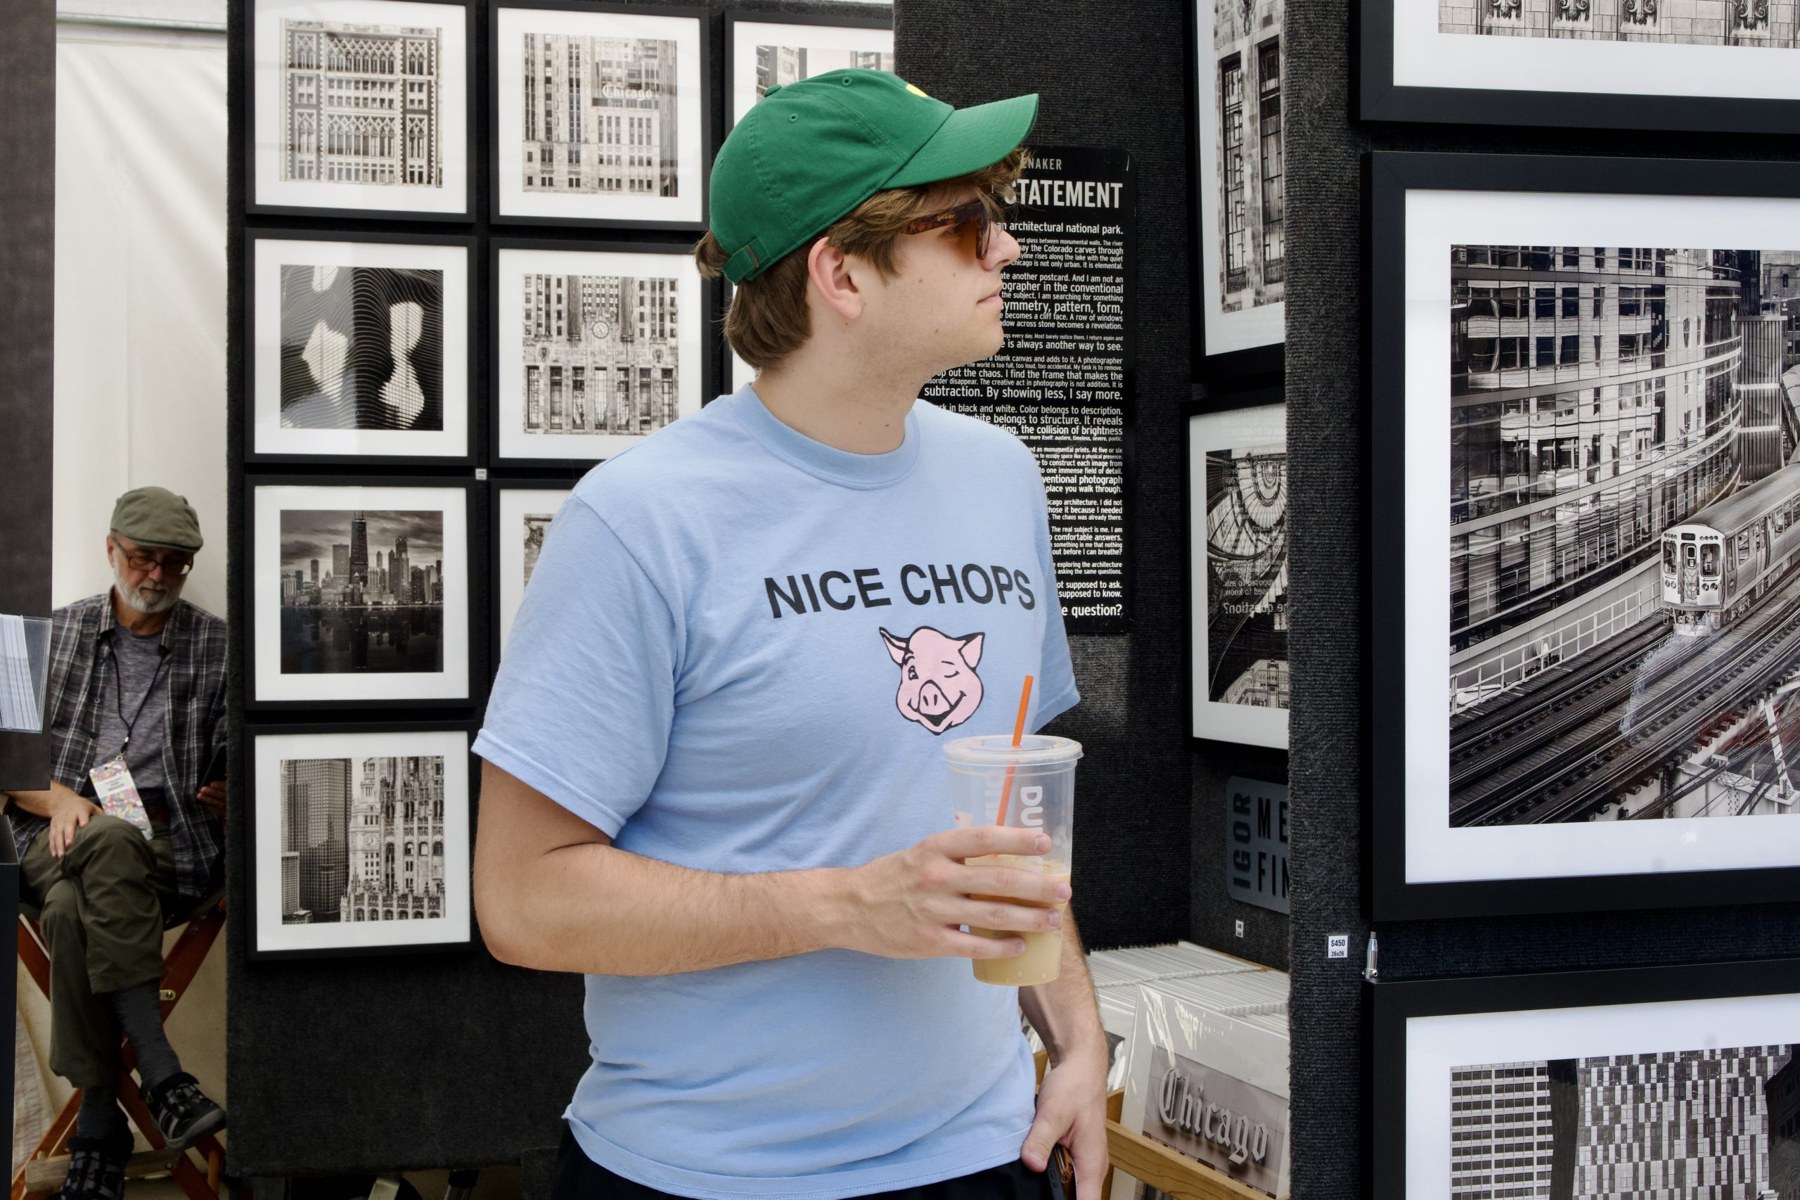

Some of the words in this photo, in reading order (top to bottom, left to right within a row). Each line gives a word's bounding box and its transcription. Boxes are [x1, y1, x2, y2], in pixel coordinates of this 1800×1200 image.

[1009, 221, 1064, 232] architectural
[1066, 223, 1100, 234] national
[1102, 224, 1123, 236] park.
[1098, 246, 1123, 256] through
[1043, 282, 1051, 291] in
[1054, 283, 1068, 291] the
[1070, 283, 1123, 293] conventional
[1093, 294, 1123, 302] something
[1054, 301, 1093, 314] pattern,
[1097, 302, 1123, 314] form,
[1008, 340, 1014, 348] is
[1016, 340, 1043, 350] always
[1046, 340, 1076, 349] another
[1078, 343, 1094, 352] way
[1096, 342, 1105, 350] to
[1083, 356, 1123, 365] photographer
[924, 386, 983, 396] subtraction.
[986, 388, 999, 399] By
[1002, 388, 1042, 400] showing
[1045, 389, 1066, 400] less,
[1076, 391, 1092, 401] say
[1041, 406, 1069, 416] belongs
[1081, 406, 1123, 416] description.
[993, 414, 1027, 426] belongs
[1029, 415, 1038, 424] to
[1040, 415, 1081, 424] structure.
[1084, 416, 1090, 424] It
[1093, 416, 1123, 425] reveals
[1021, 425, 1035, 434] the
[1037, 425, 1069, 434] collision
[1071, 426, 1079, 434] of
[1081, 426, 1123, 437] brightness
[1079, 475, 1123, 485] photograph
[1045, 485, 1063, 494] place
[1095, 485, 1123, 494] through.
[764, 568, 892, 618] NICE
[900, 564, 1035, 610] CHOPS
[1066, 581, 1098, 590] supposed
[1058, 590, 1091, 599] supposed
[1071, 604, 1123, 618] question?
[1233, 792, 1251, 890] IGOR
[1158, 1066, 1269, 1165] Chicago
